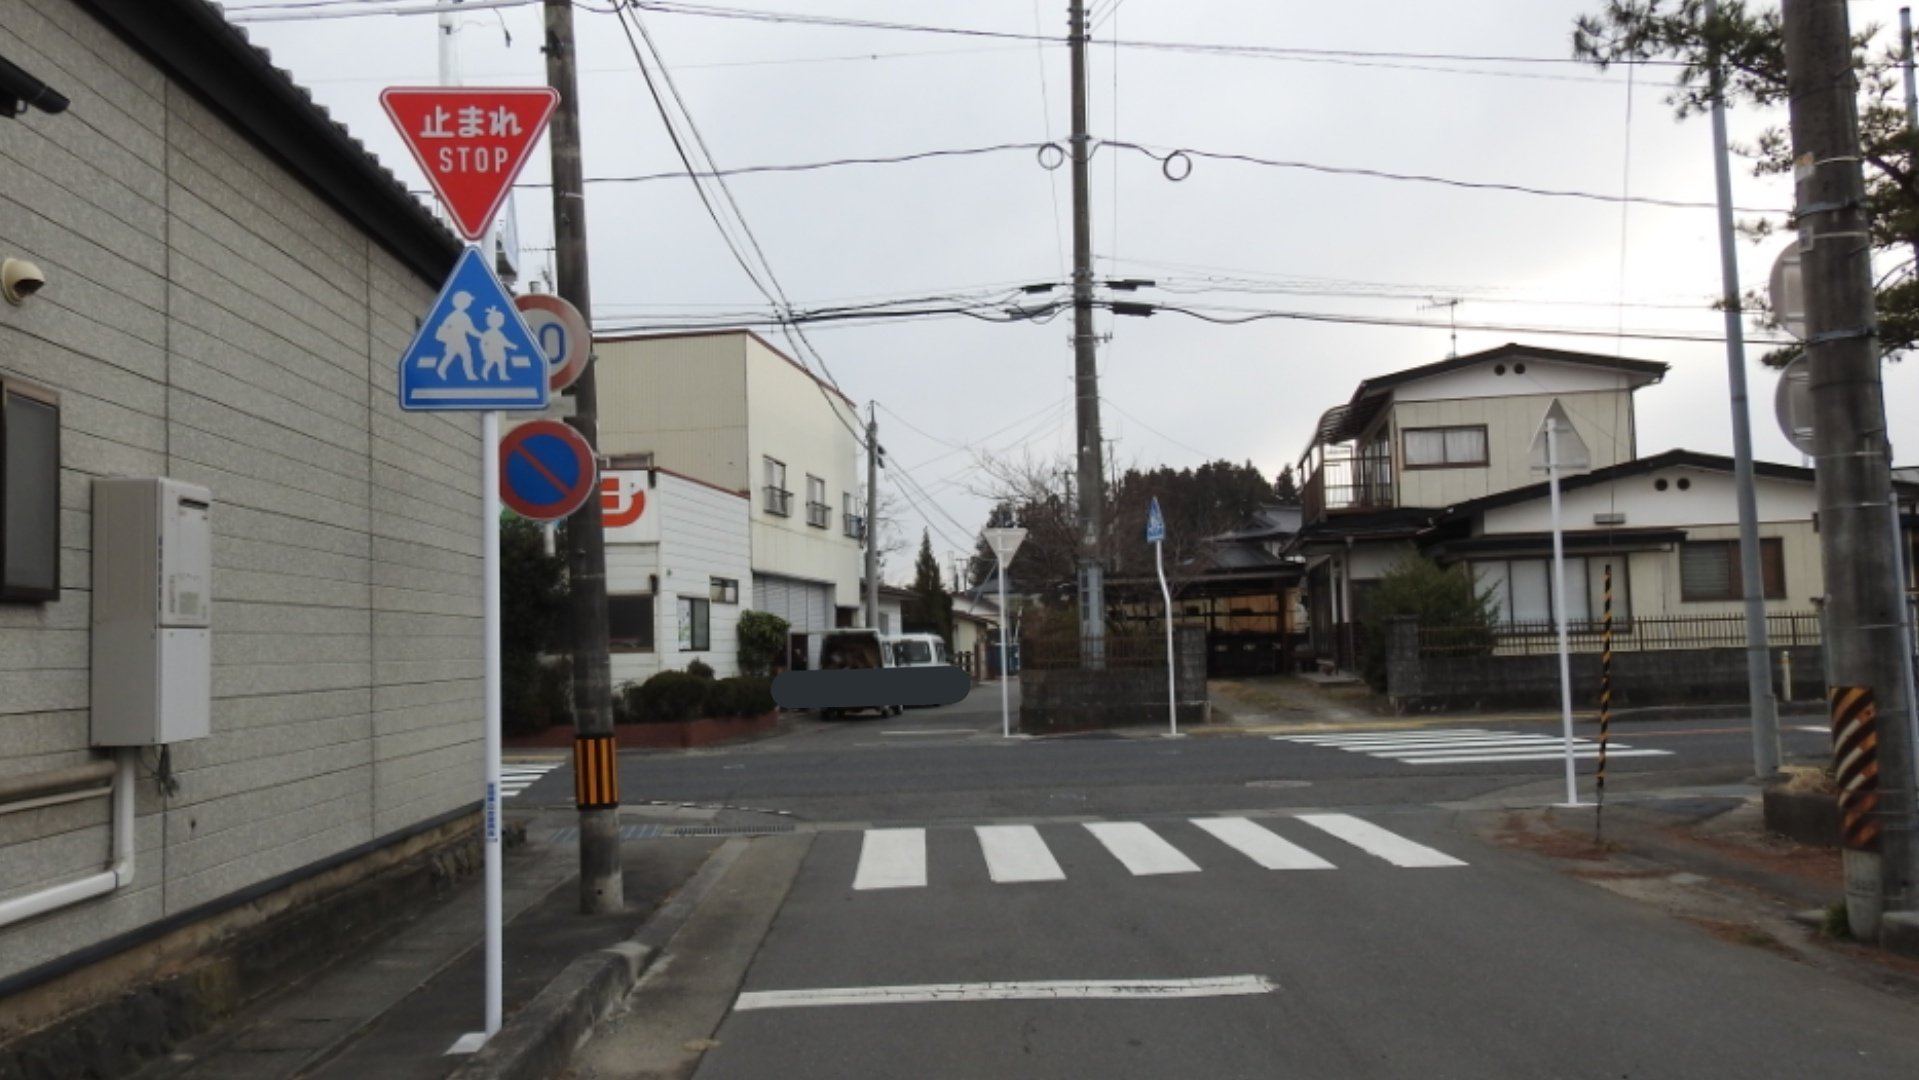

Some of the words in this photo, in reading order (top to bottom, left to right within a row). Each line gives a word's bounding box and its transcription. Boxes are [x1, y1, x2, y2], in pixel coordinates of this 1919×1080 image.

[419, 105, 523, 138] 止まれ
[439, 147, 508, 172] STOP
[540, 323, 566, 365] 0
